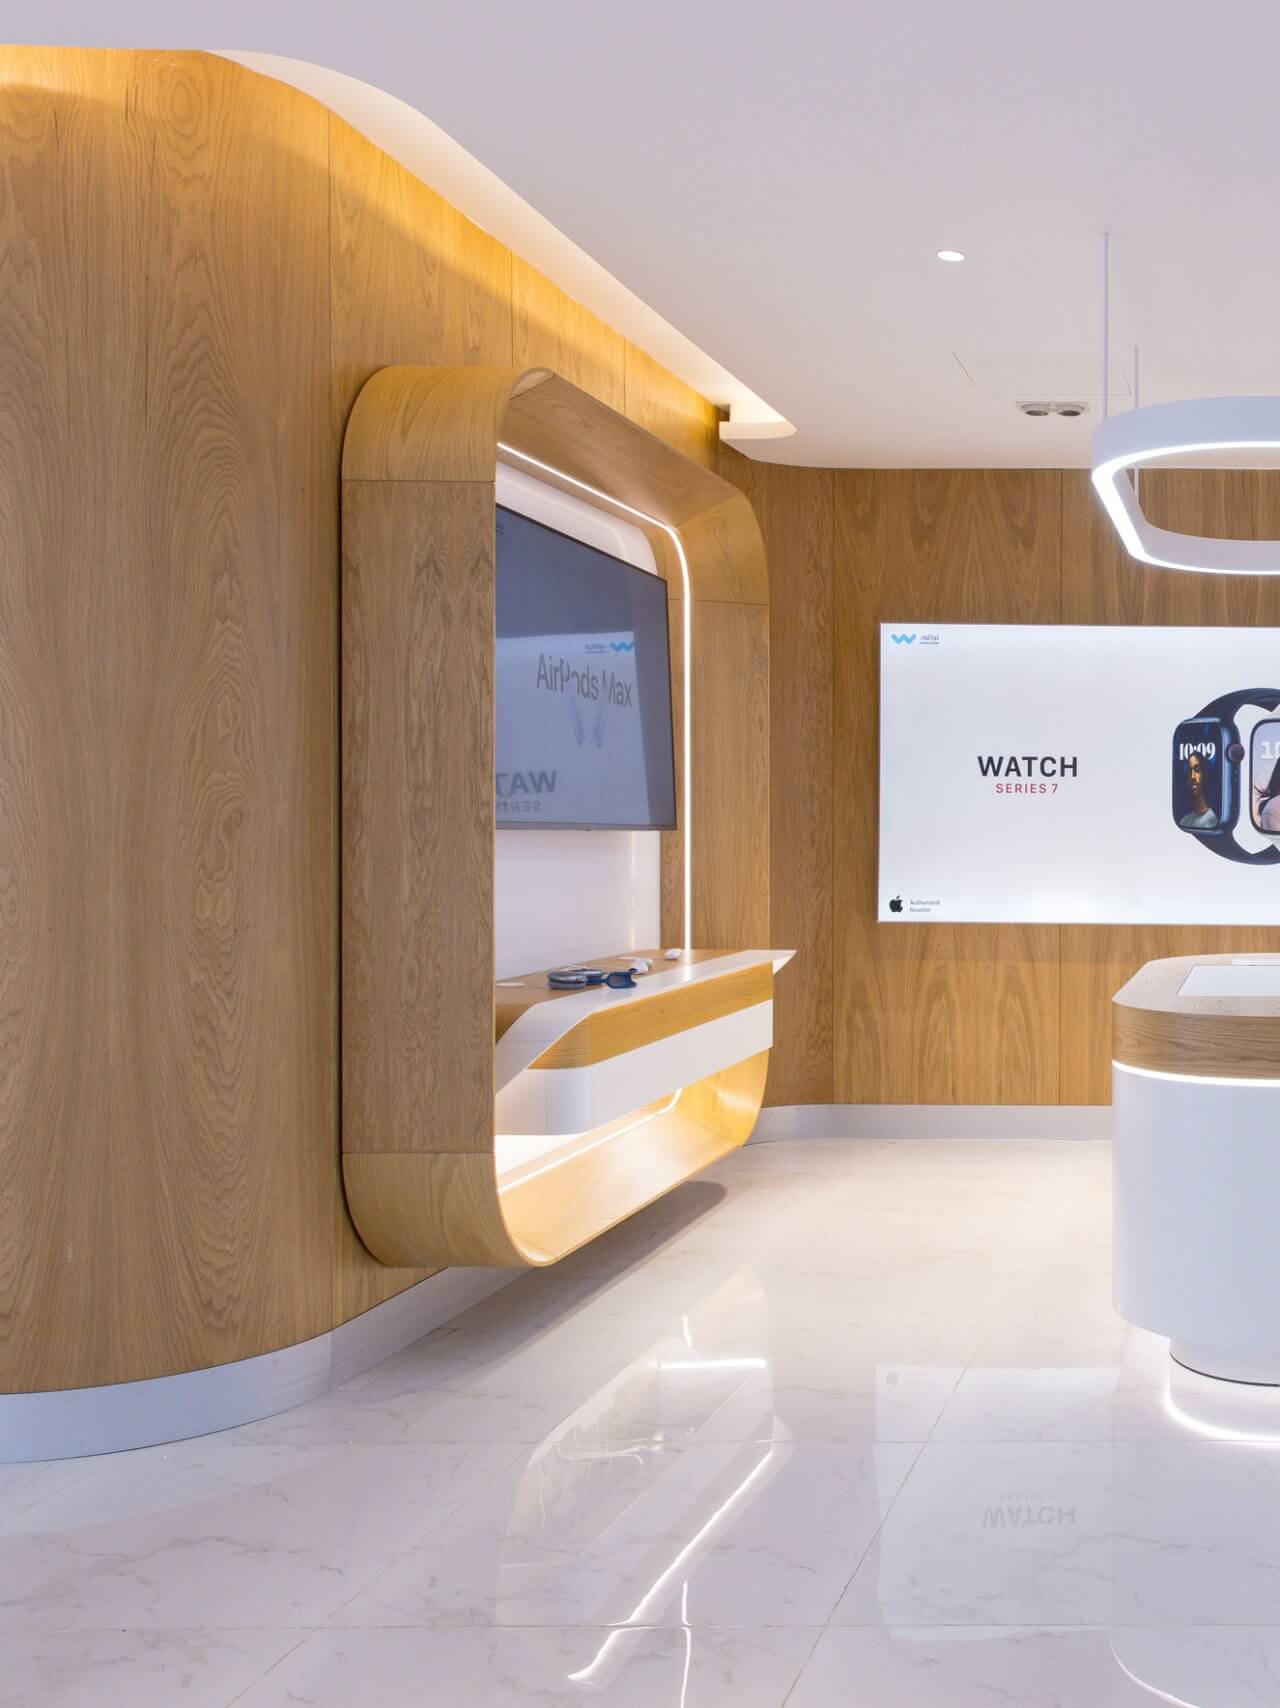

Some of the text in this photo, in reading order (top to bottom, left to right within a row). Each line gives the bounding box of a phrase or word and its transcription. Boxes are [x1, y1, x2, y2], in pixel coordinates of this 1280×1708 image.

[977, 755, 1079, 777] WATCH
[995, 783, 1059, 794] SERIES 7
